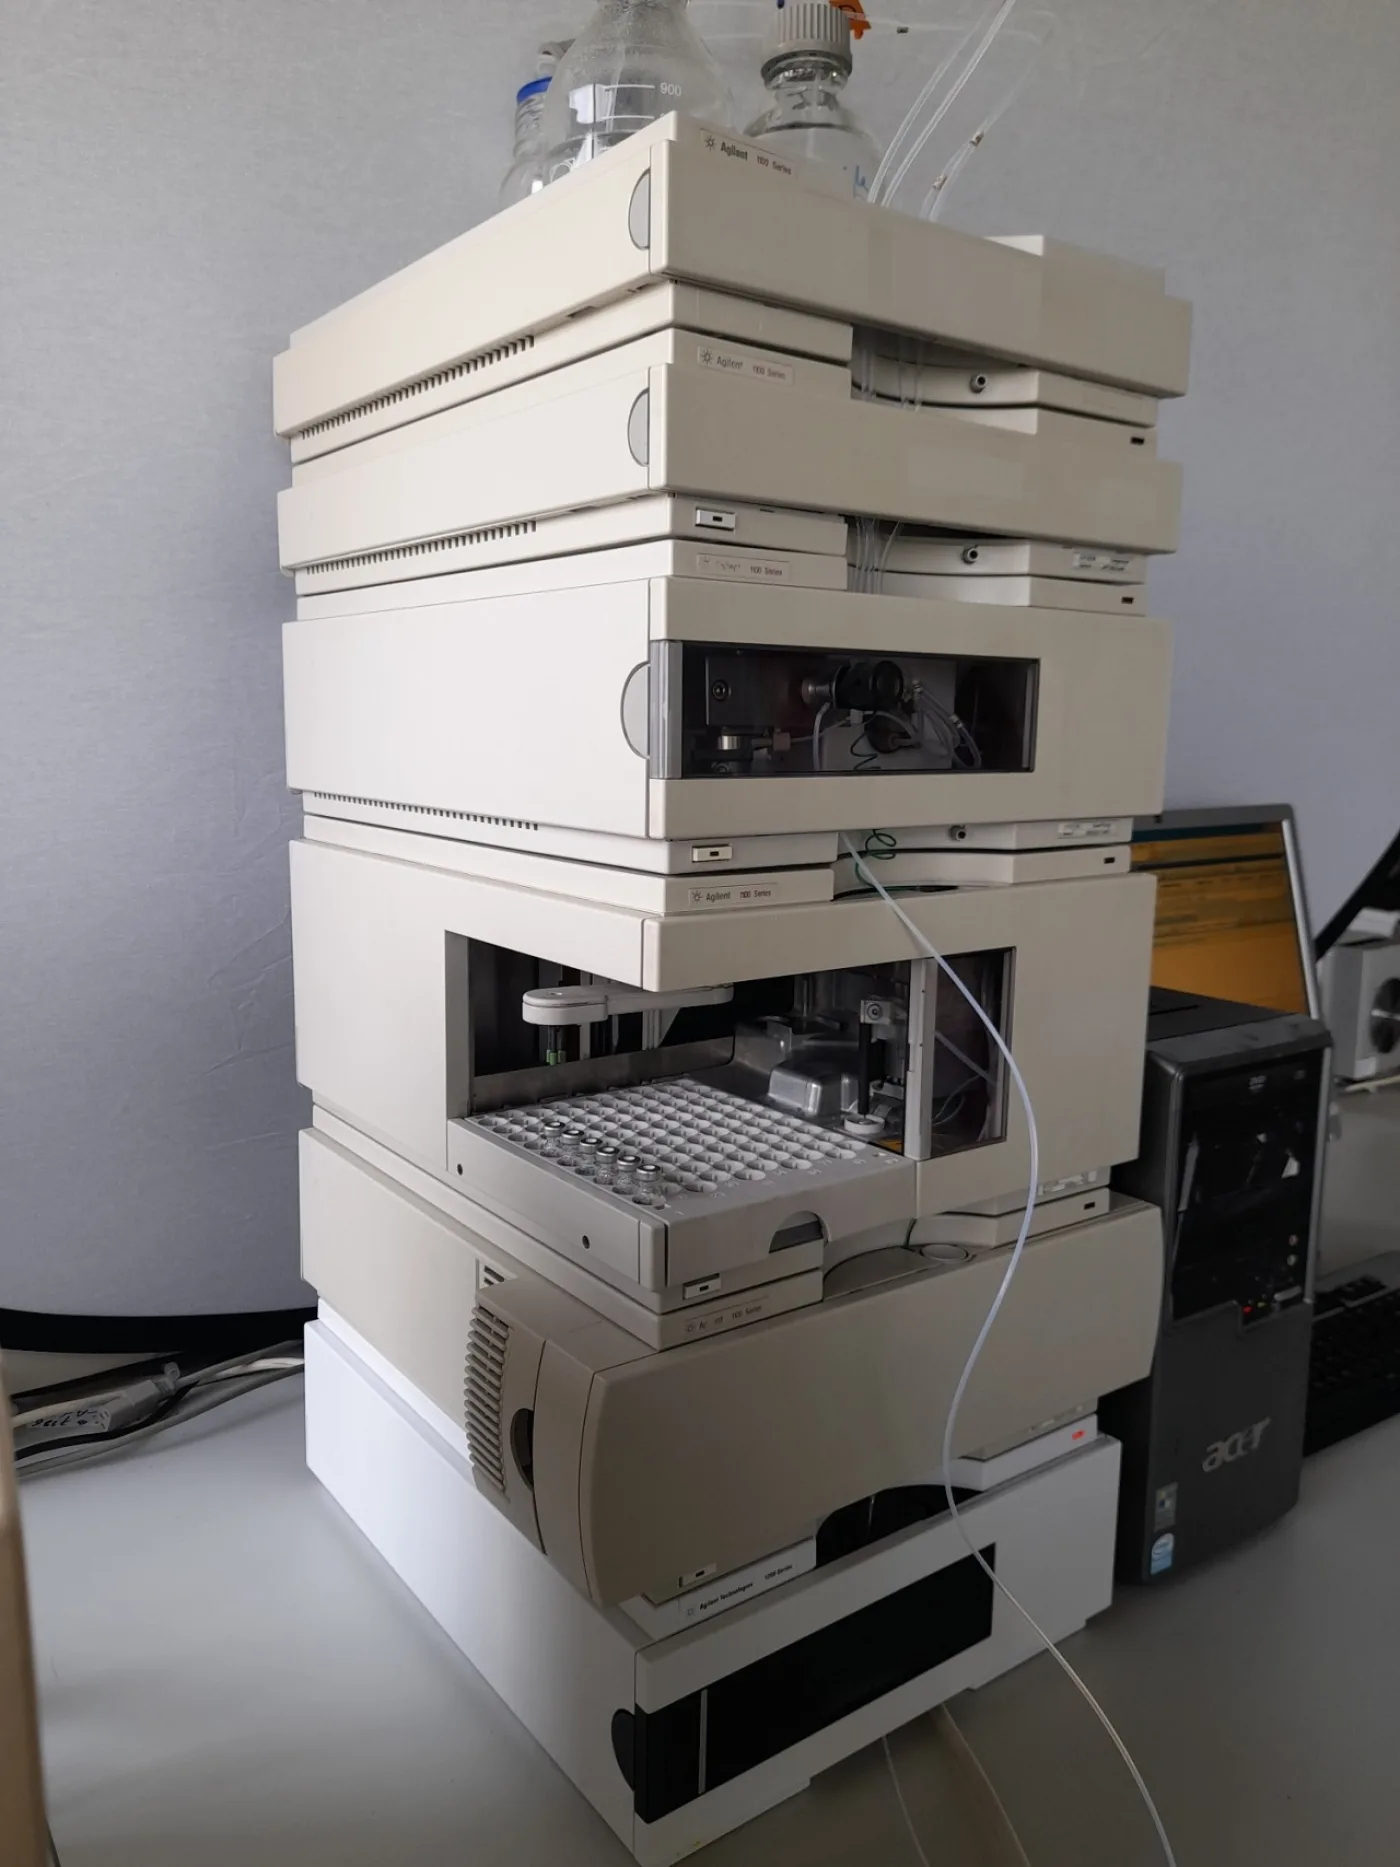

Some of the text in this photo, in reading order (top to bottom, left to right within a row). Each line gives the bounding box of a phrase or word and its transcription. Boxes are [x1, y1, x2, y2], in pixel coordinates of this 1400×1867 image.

[660, 82, 682, 96] 900
[720, 141, 748, 161] Agilent
[716, 355, 744, 371] Agilent
[764, 566, 783, 576] Series
[705, 891, 731, 903] Agilent
[754, 889, 771, 898] Series
[1202, 1416, 1272, 1473] acer
